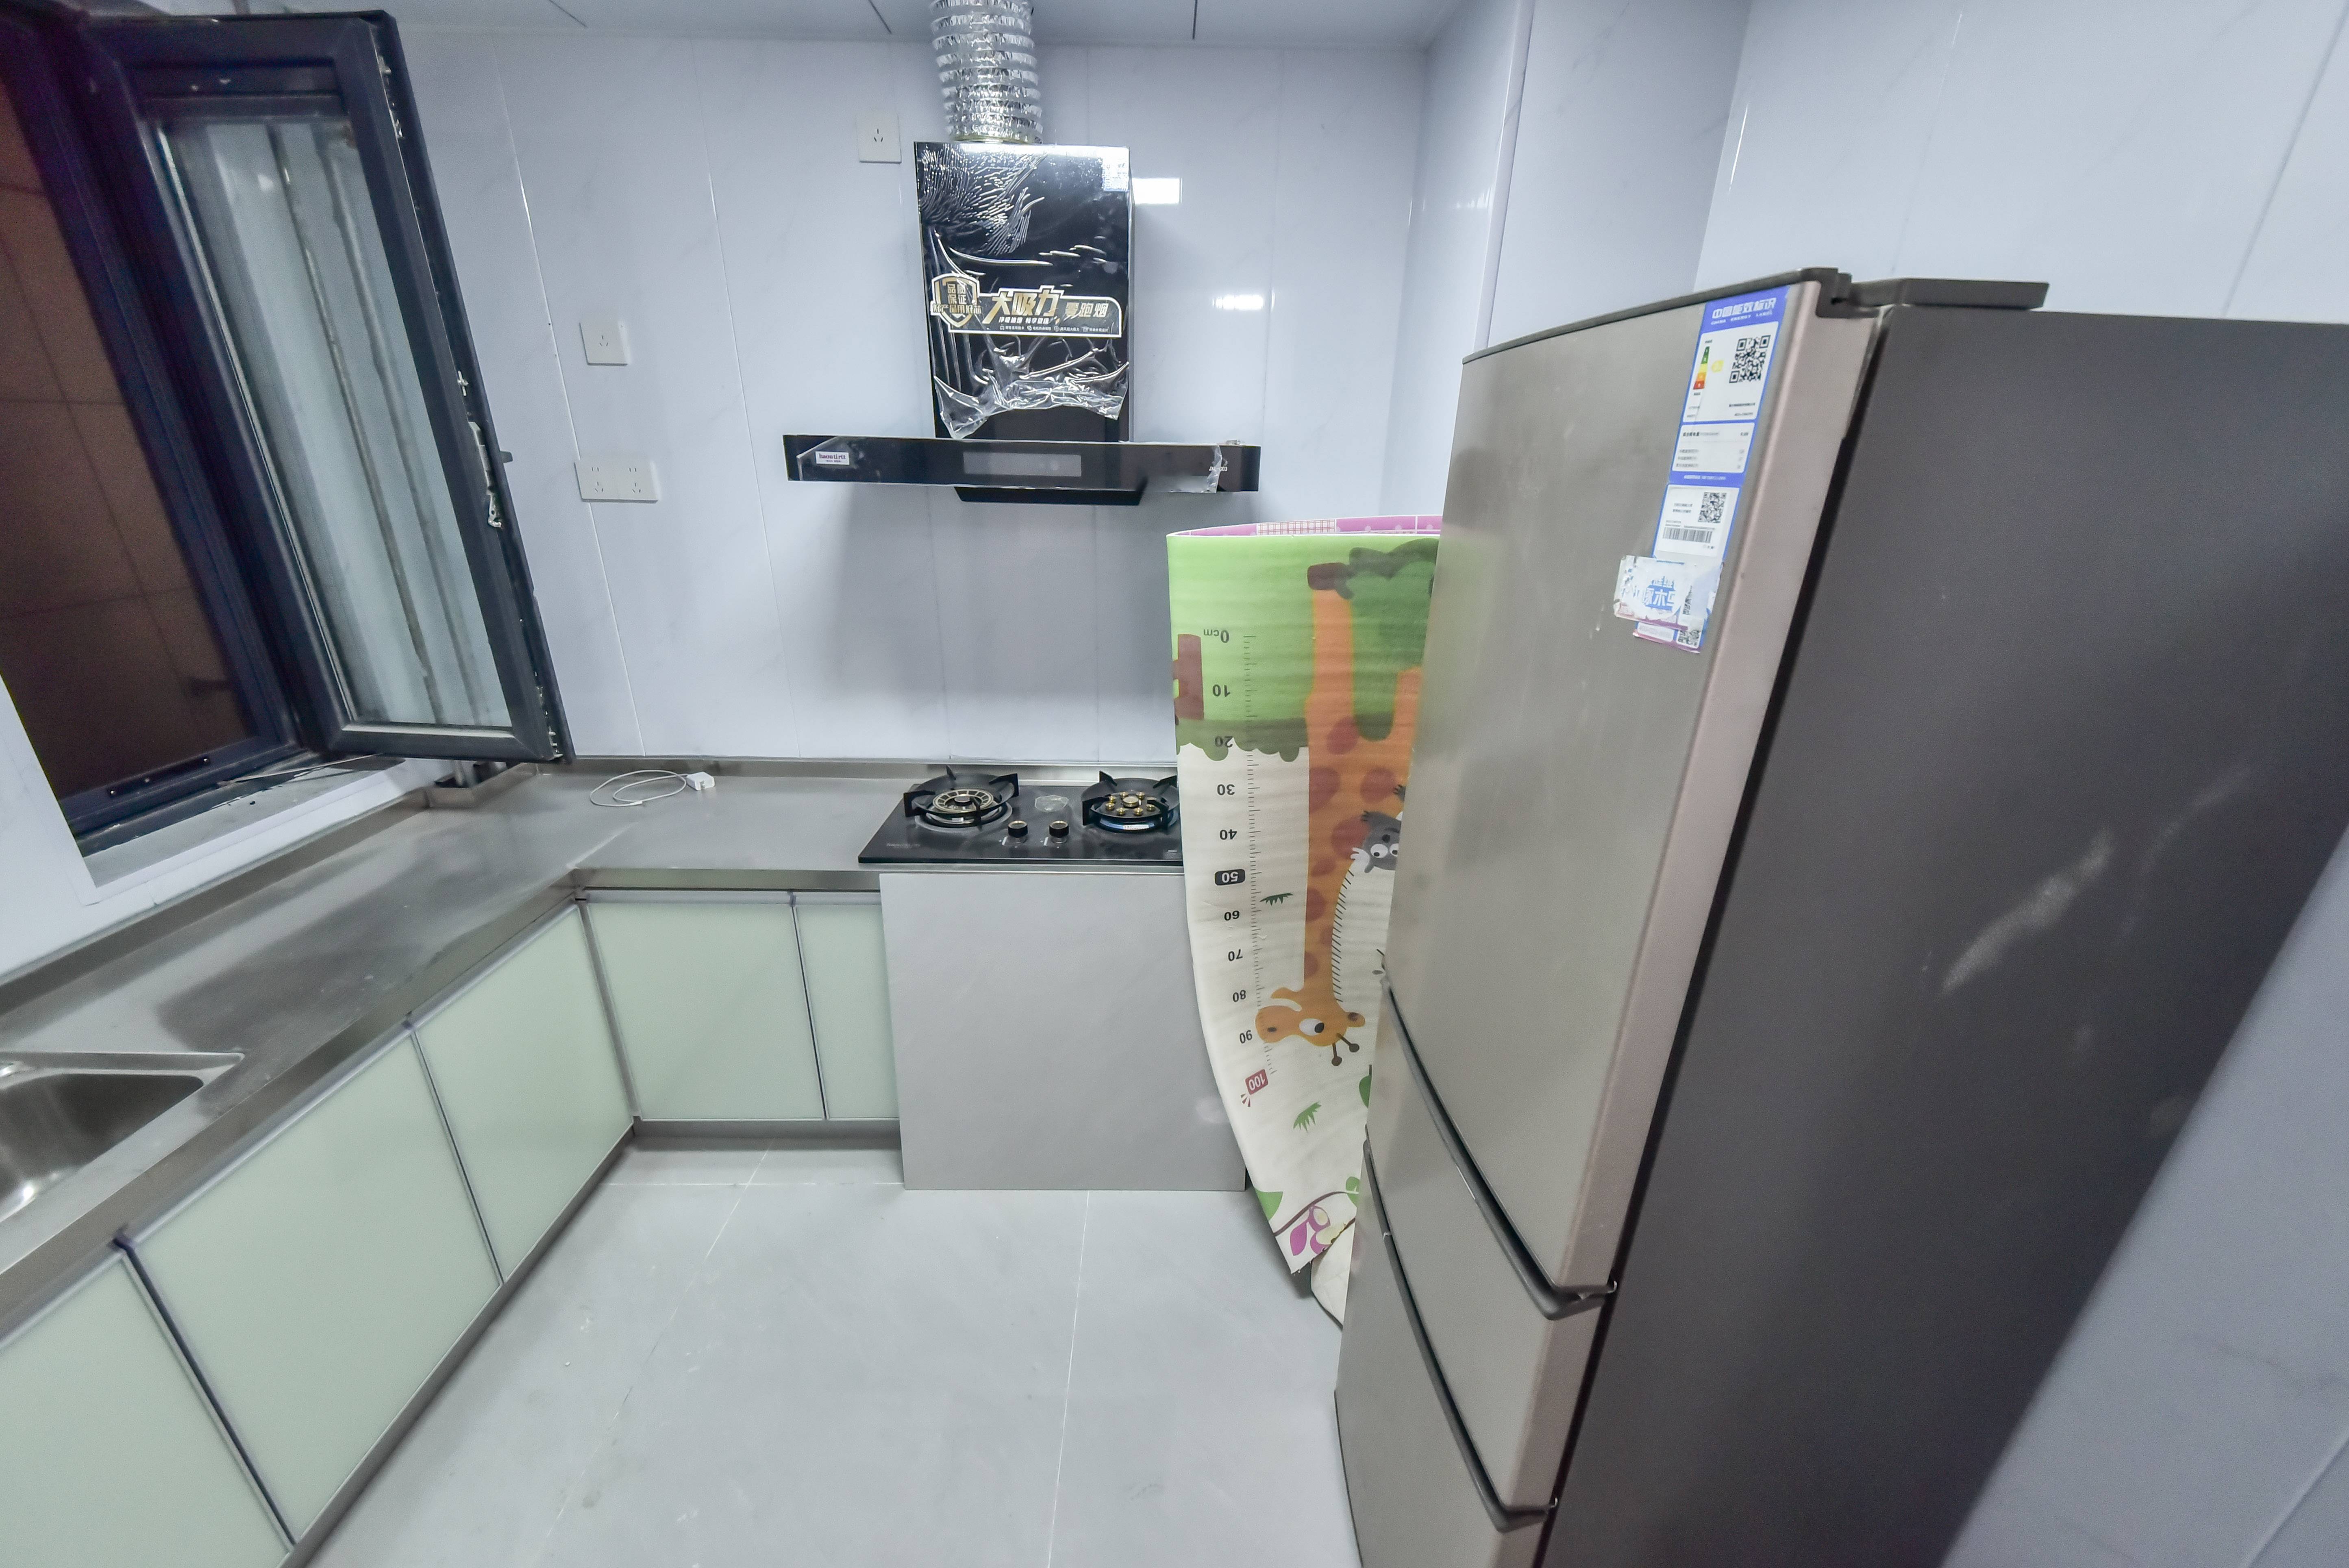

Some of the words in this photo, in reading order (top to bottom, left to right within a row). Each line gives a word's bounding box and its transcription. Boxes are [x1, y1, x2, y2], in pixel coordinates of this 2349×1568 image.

[982, 289, 1059, 324] 大吸力
[1203, 629, 1229, 643] 0cm
[1212, 684, 1231, 697] 10
[1215, 735, 1233, 748] 20
[1217, 784, 1235, 796] 30
[1220, 829, 1237, 840] 40
[1221, 871, 1239, 883] 50
[1224, 910, 1240, 921] 60
[1228, 949, 1243, 961] 70
[1232, 990, 1246, 1003] 80
[1240, 1030, 1253, 1044] 90
[1248, 1073, 1266, 1090] 100
